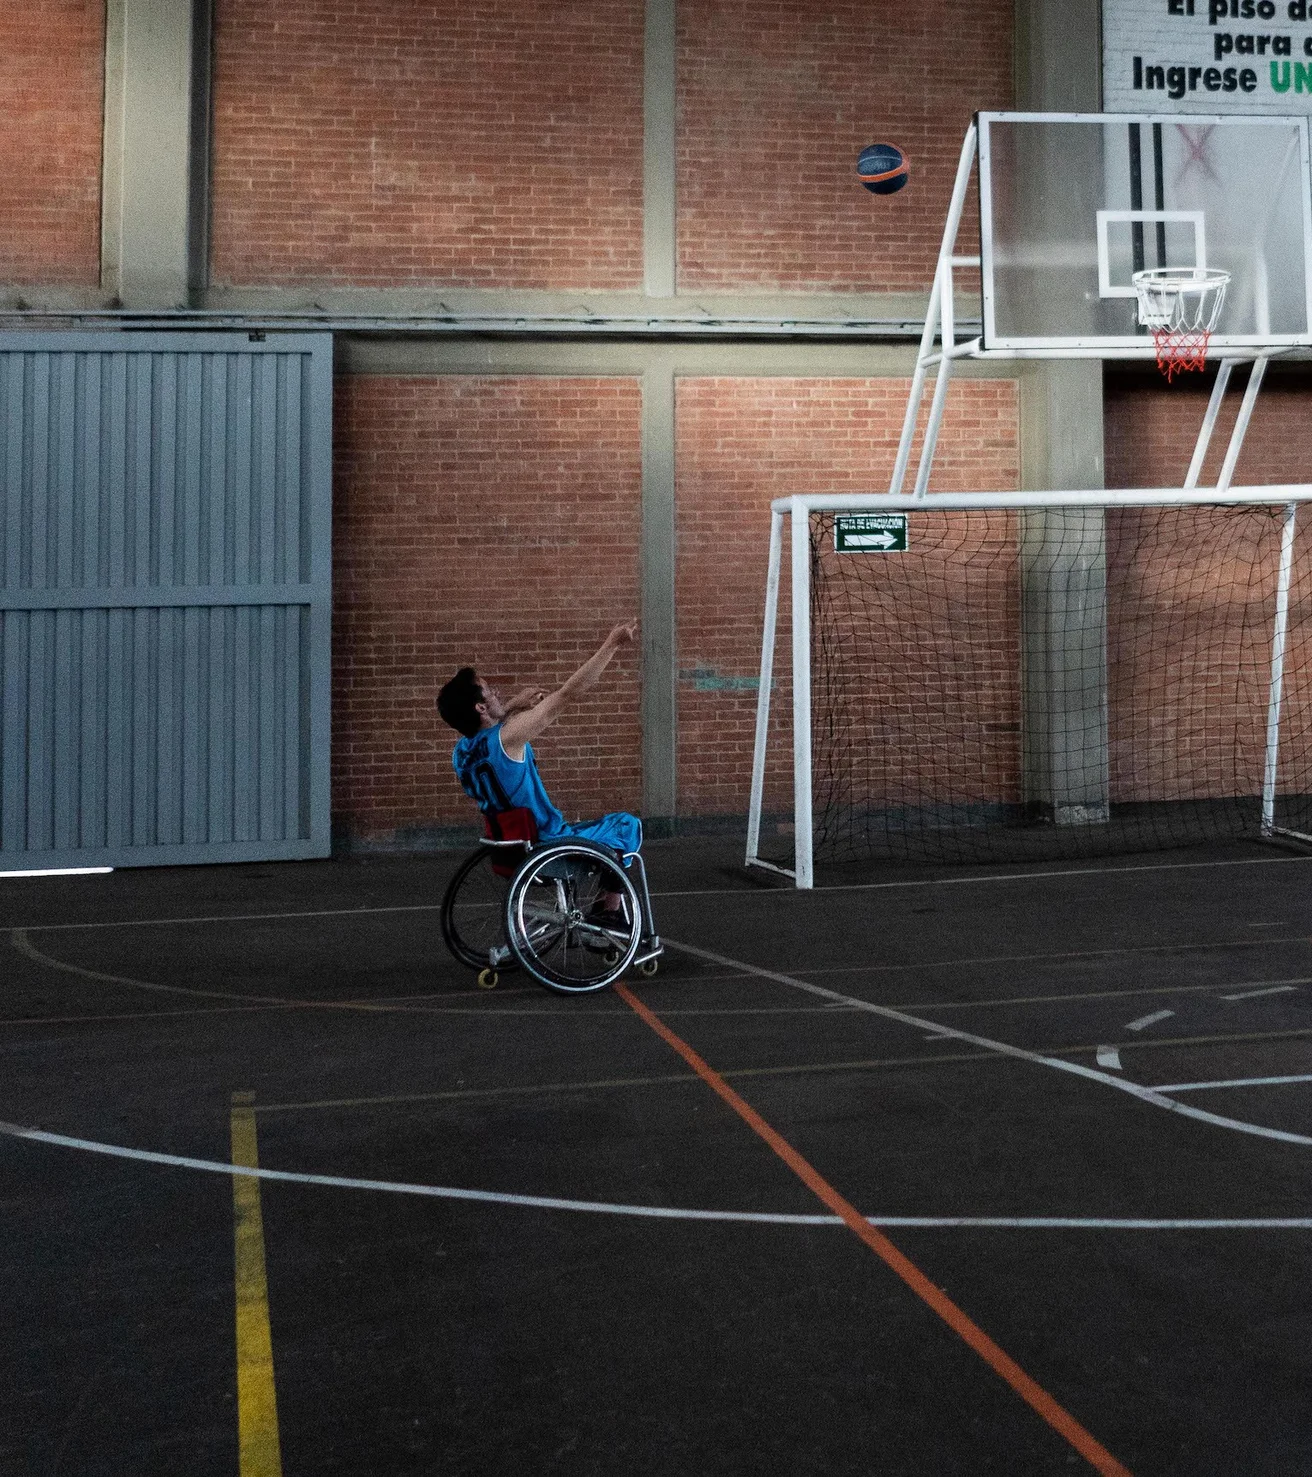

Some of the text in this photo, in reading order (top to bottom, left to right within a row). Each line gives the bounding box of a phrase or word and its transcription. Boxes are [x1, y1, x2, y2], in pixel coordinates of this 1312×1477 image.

[1209, 0, 1275, 25] piso
[1214, 33, 1291, 61] para
[1133, 56, 1258, 99] Ingrese
